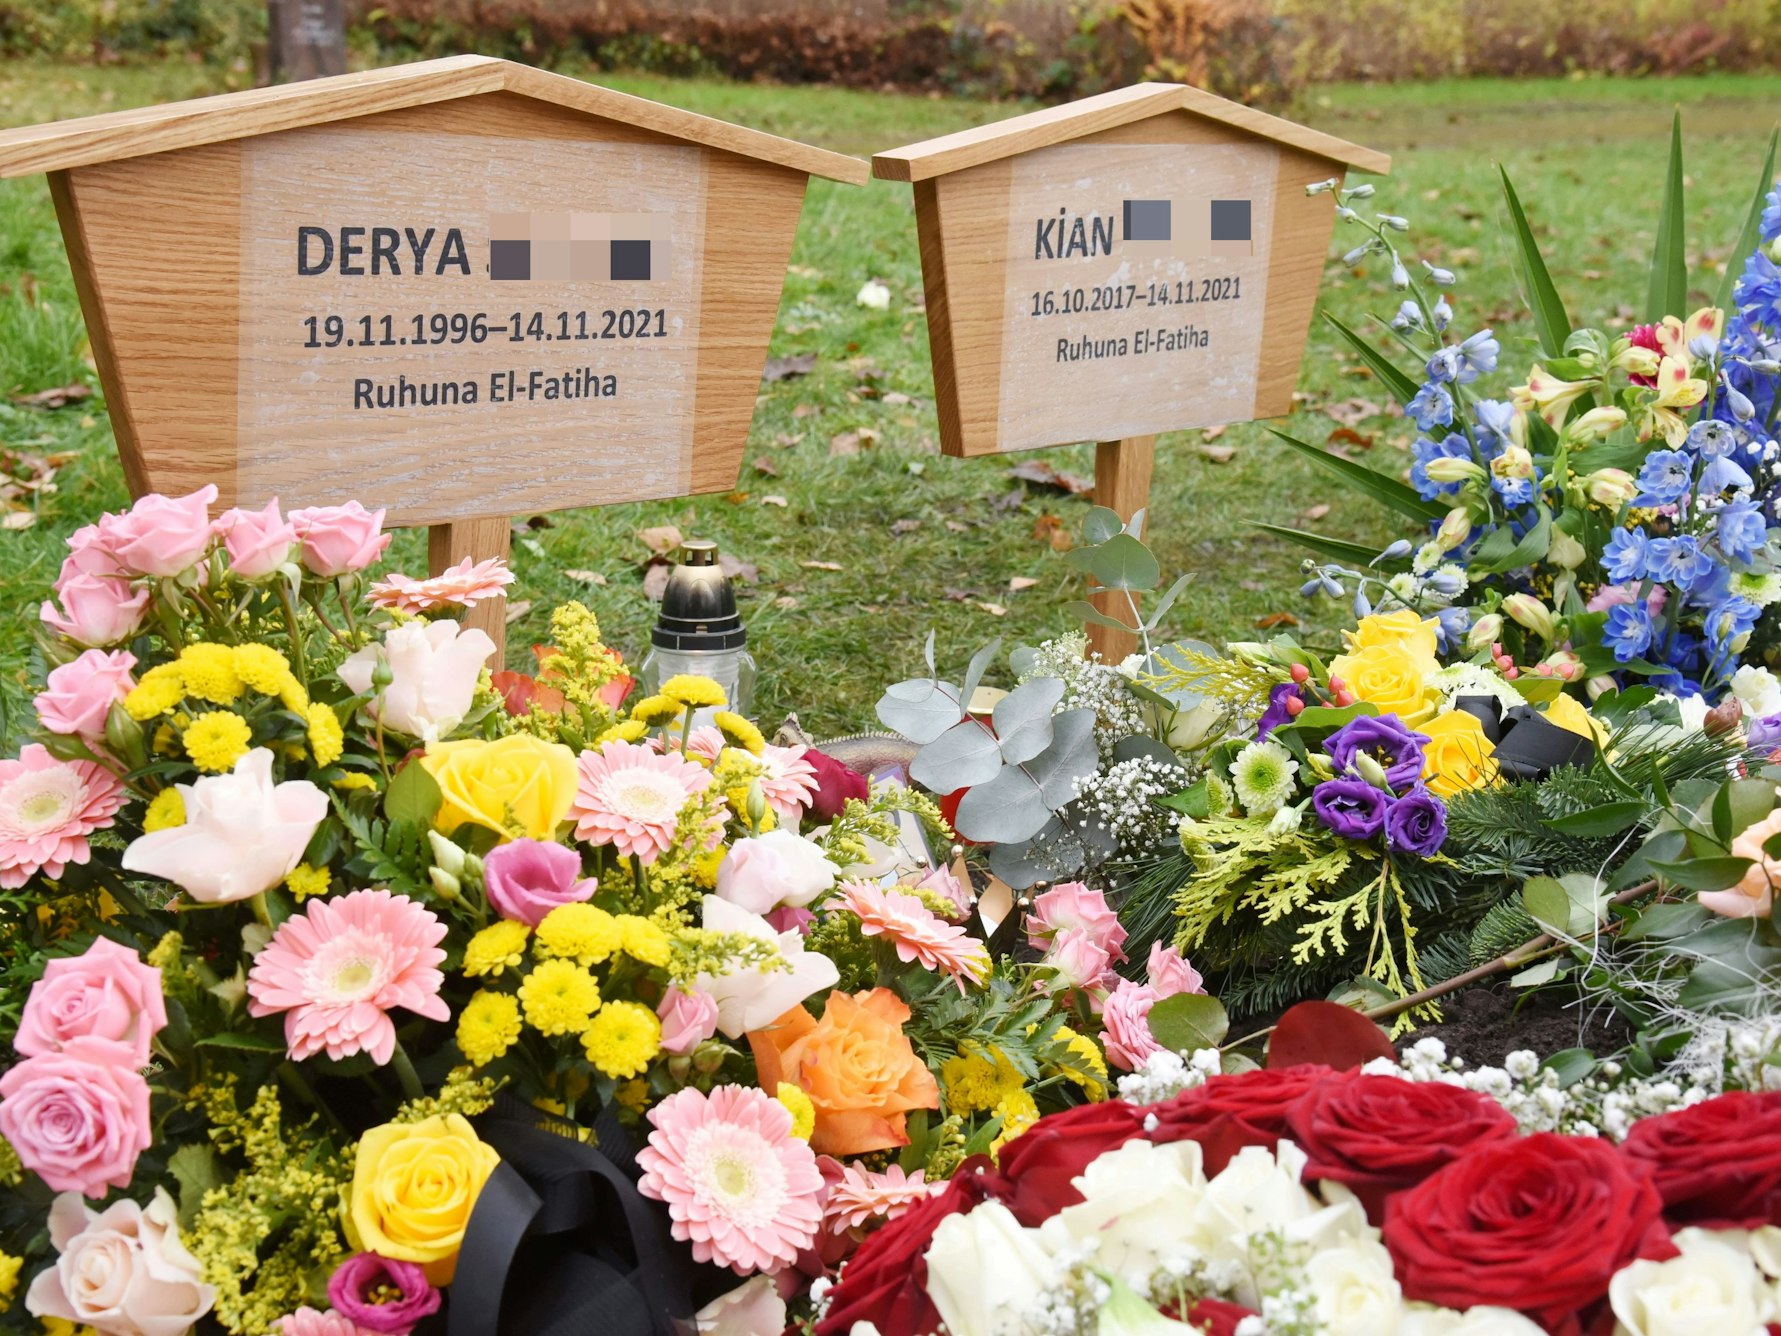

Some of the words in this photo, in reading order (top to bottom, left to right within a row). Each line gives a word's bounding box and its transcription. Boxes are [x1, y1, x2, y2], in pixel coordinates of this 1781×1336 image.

[297, 226, 471, 276] DERYA
[1034, 206, 1114, 260] KİAN
[1030, 276, 1241, 316] 16.10.2017–14.11.2021
[303, 309, 668, 348] 19.11.1996–14.11.2021
[1056, 334, 1127, 362] Ruhuna
[1133, 325, 1209, 355] El-Fatiha
[353, 375, 478, 409] Ruhuna
[489, 367, 617, 402] El-Fatiha
